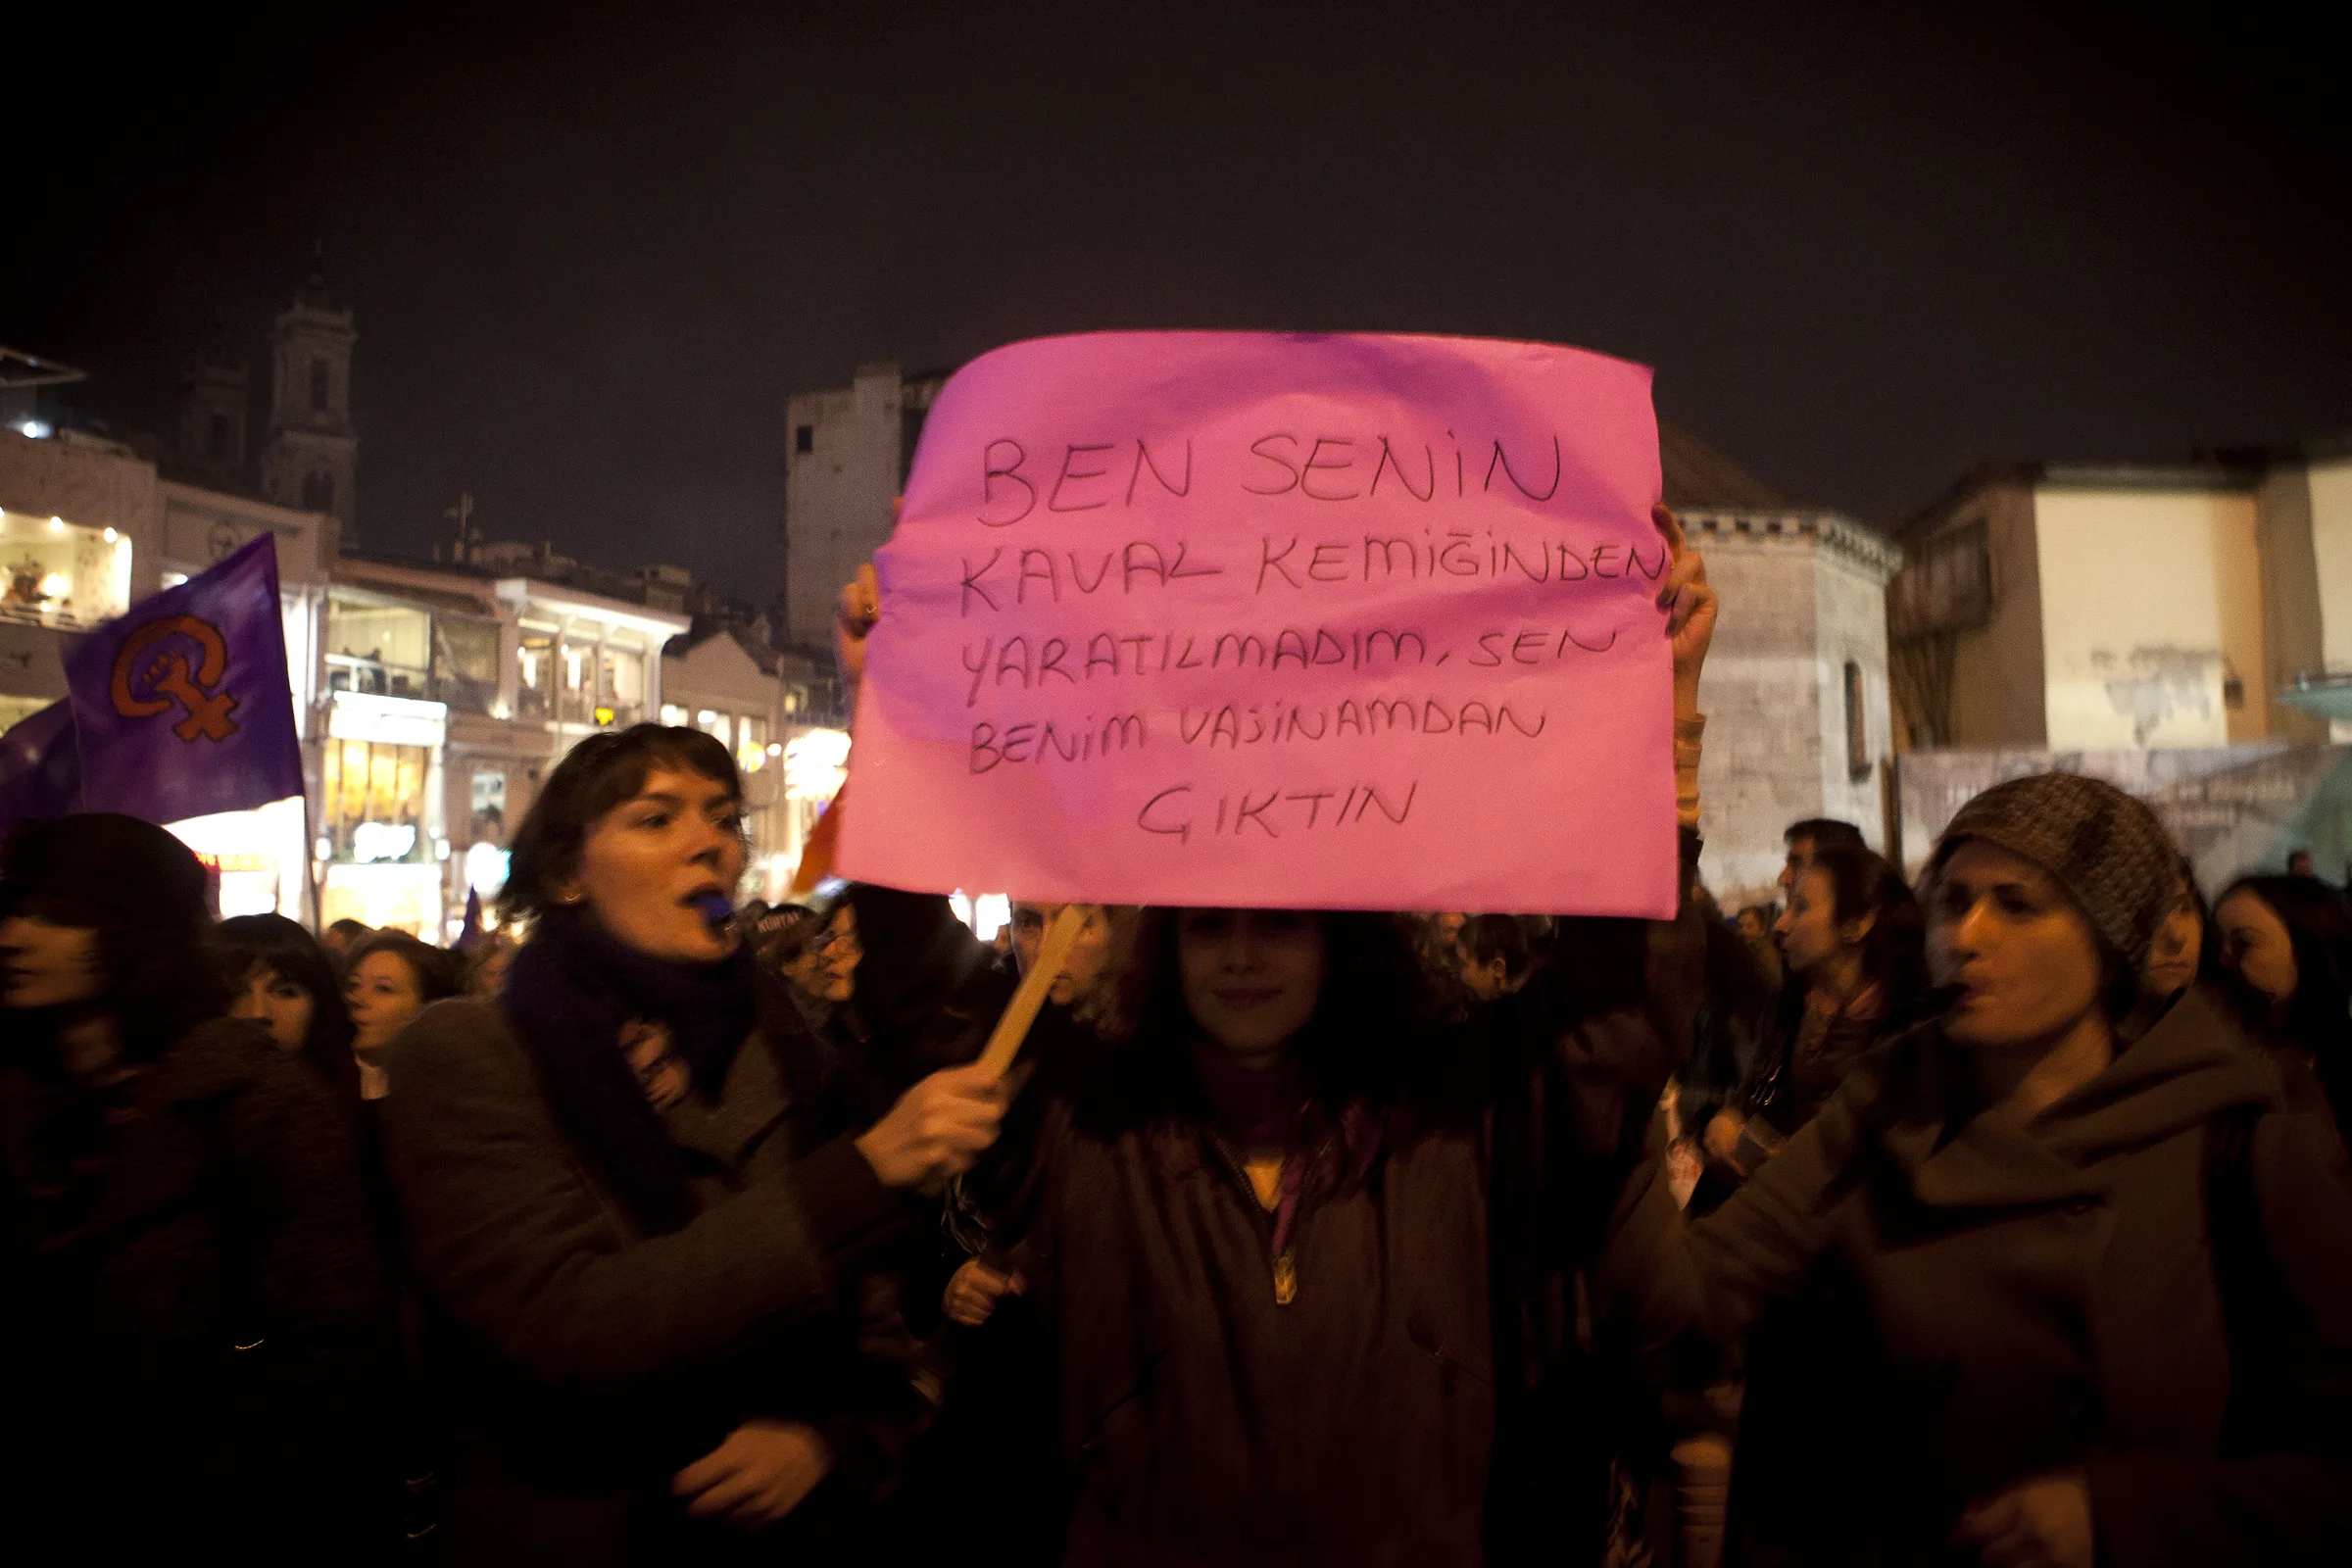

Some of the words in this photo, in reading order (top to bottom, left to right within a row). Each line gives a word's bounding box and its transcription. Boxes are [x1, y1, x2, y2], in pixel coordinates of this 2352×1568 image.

[977, 438, 1193, 527] BEN
[958, 541, 1224, 618] KAVAL
[1468, 627, 1617, 668] SEN
